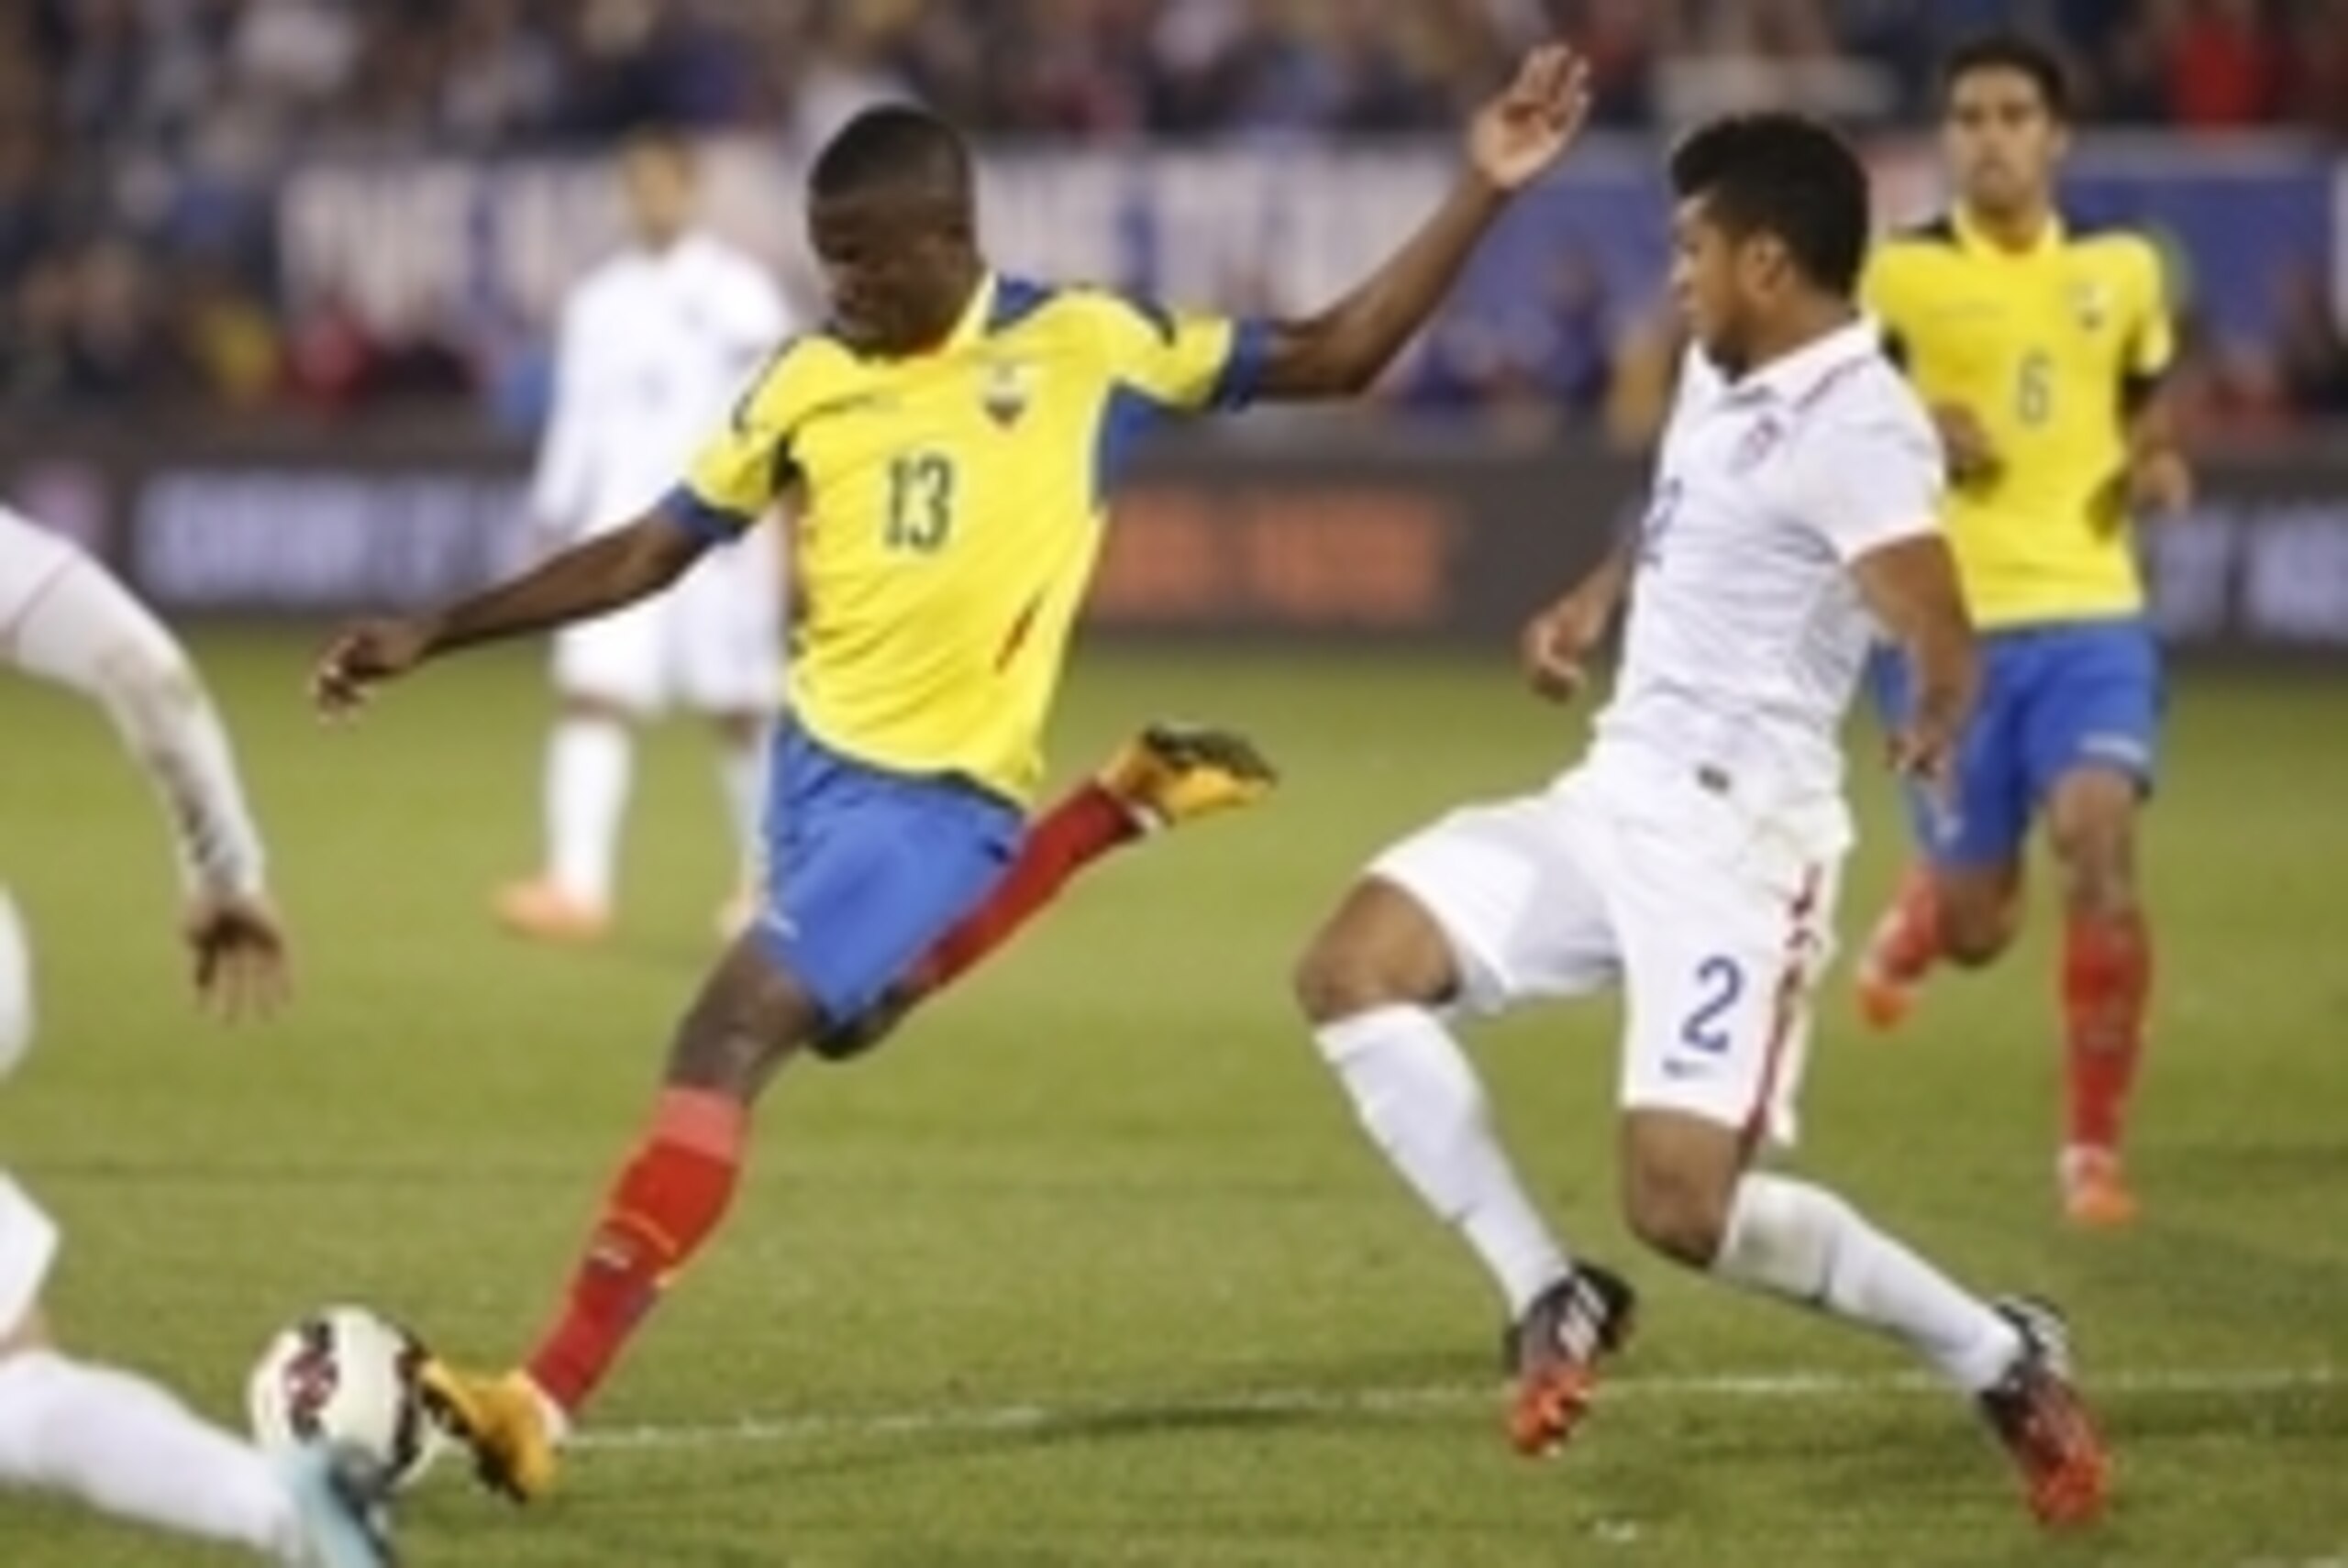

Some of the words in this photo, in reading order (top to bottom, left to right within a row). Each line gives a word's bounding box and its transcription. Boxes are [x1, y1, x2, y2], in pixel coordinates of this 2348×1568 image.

[2017, 348, 2054, 428] 6
[886, 451, 954, 554] 13
[1682, 955, 1743, 1053] 2
